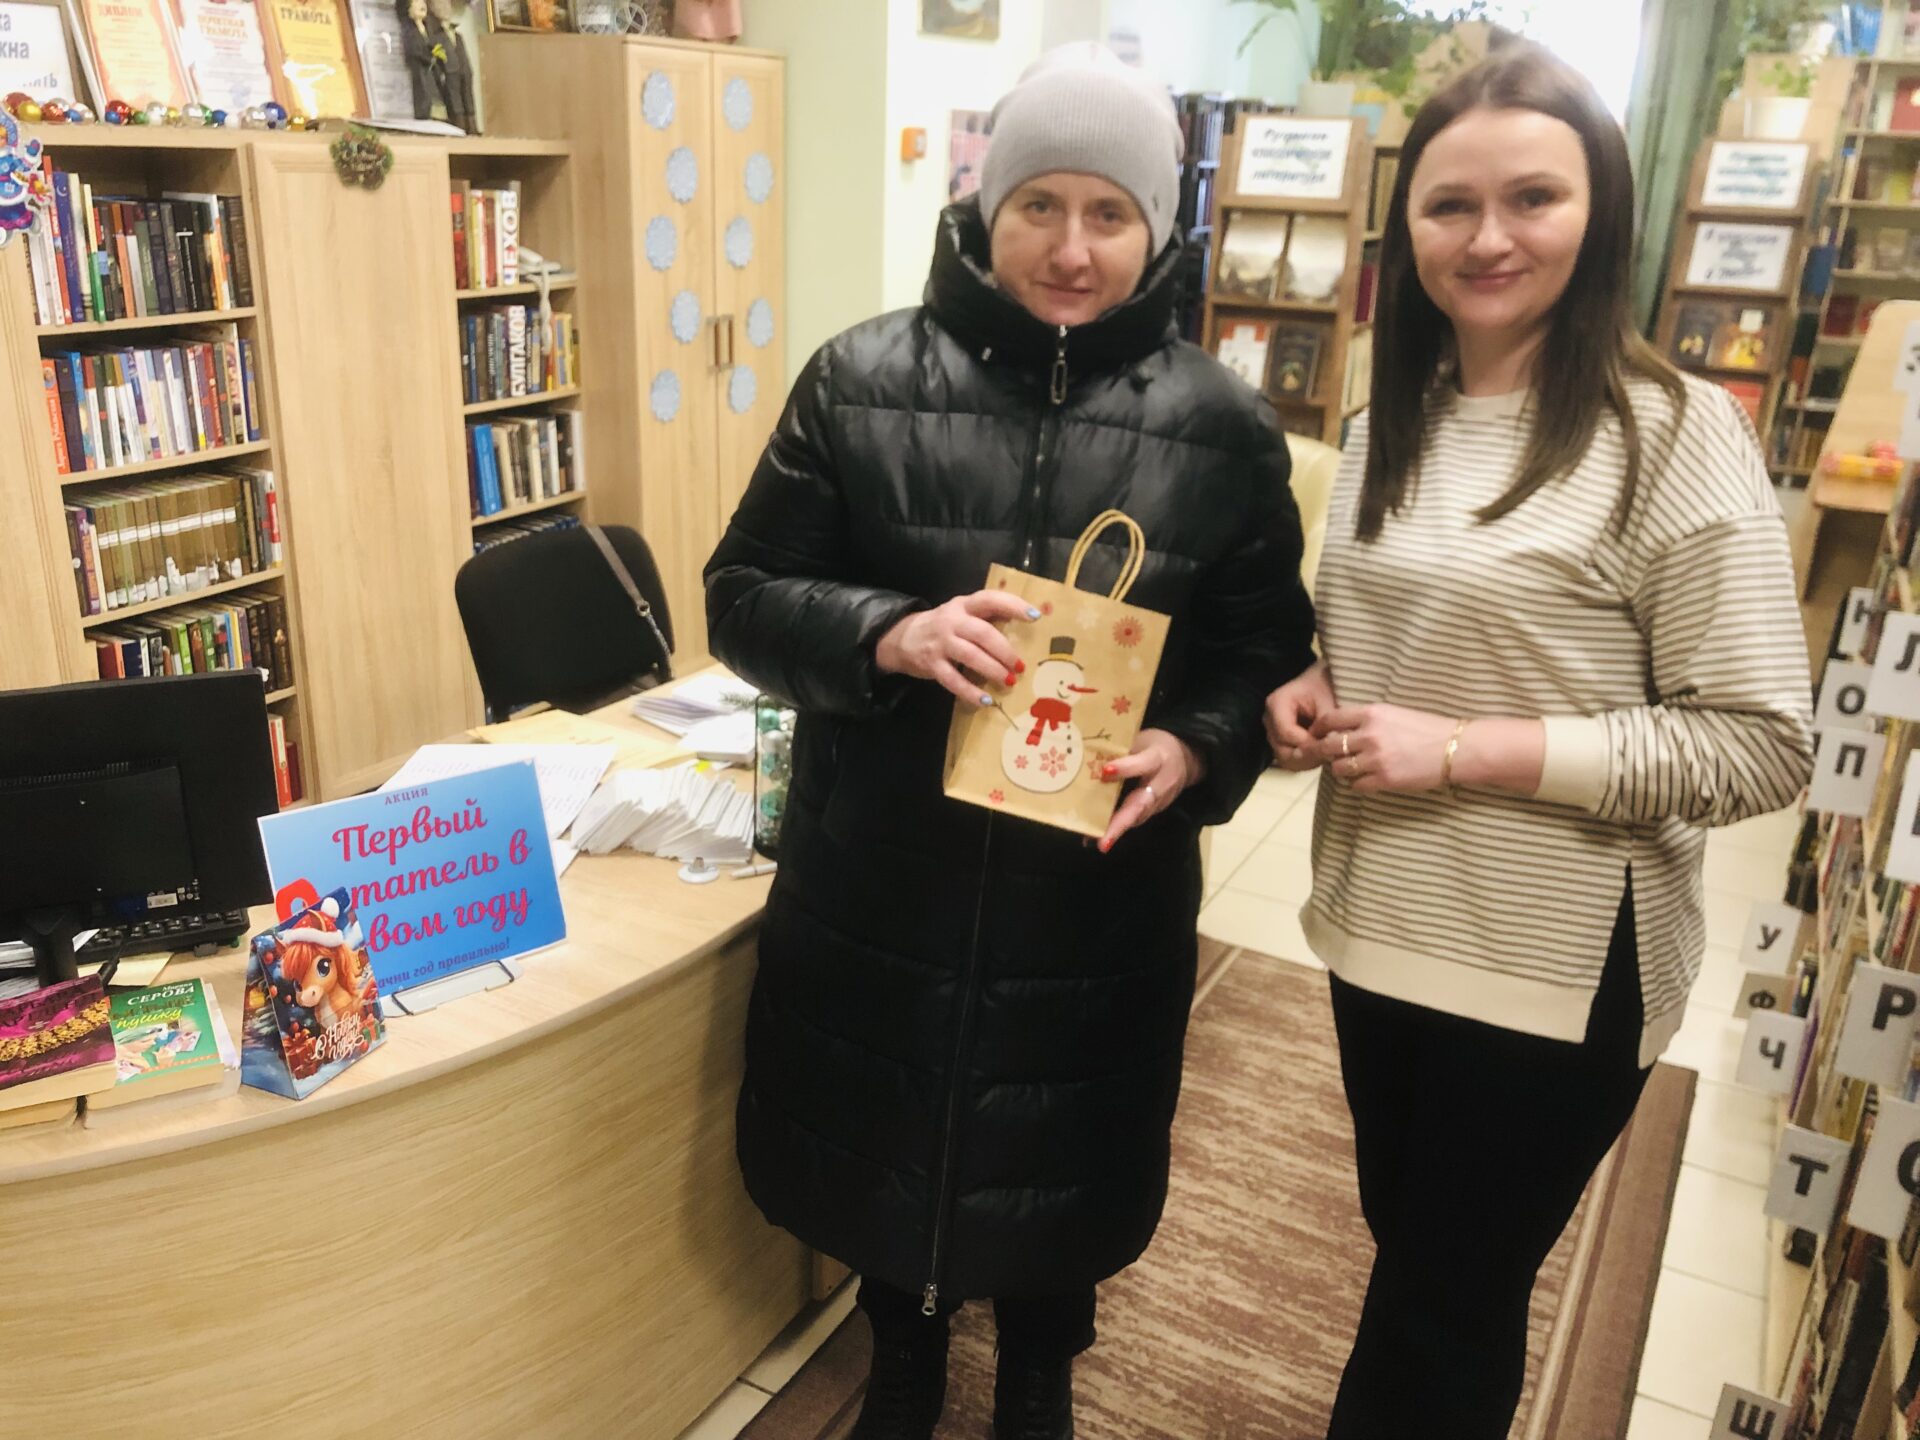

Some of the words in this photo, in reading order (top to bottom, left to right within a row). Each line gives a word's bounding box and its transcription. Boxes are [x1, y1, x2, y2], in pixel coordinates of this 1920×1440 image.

[280, 7, 332, 25] ГРАМОТА
[501, 190, 519, 286] ЧЕХОВ
[508, 305, 527, 397] БУЛГАКОВ
[1836, 685, 1866, 715] О
[1834, 744, 1866, 777] П
[384, 787, 429, 806] АКЦИЯ
[332, 798, 488, 866] Первый
[350, 851, 500, 910] татель
[509, 828, 533, 865] в
[365, 913, 448, 953] вом
[453, 888, 533, 933] году
[378, 970, 411, 989] ачни
[413, 960, 435, 979] год
[438, 937, 510, 971] правильно!
[127, 985, 194, 1006] СЕРОВА
[1872, 982, 1917, 1031] Р
[1758, 1036, 1786, 1070] Ч
[1788, 1153, 1829, 1197] Т
